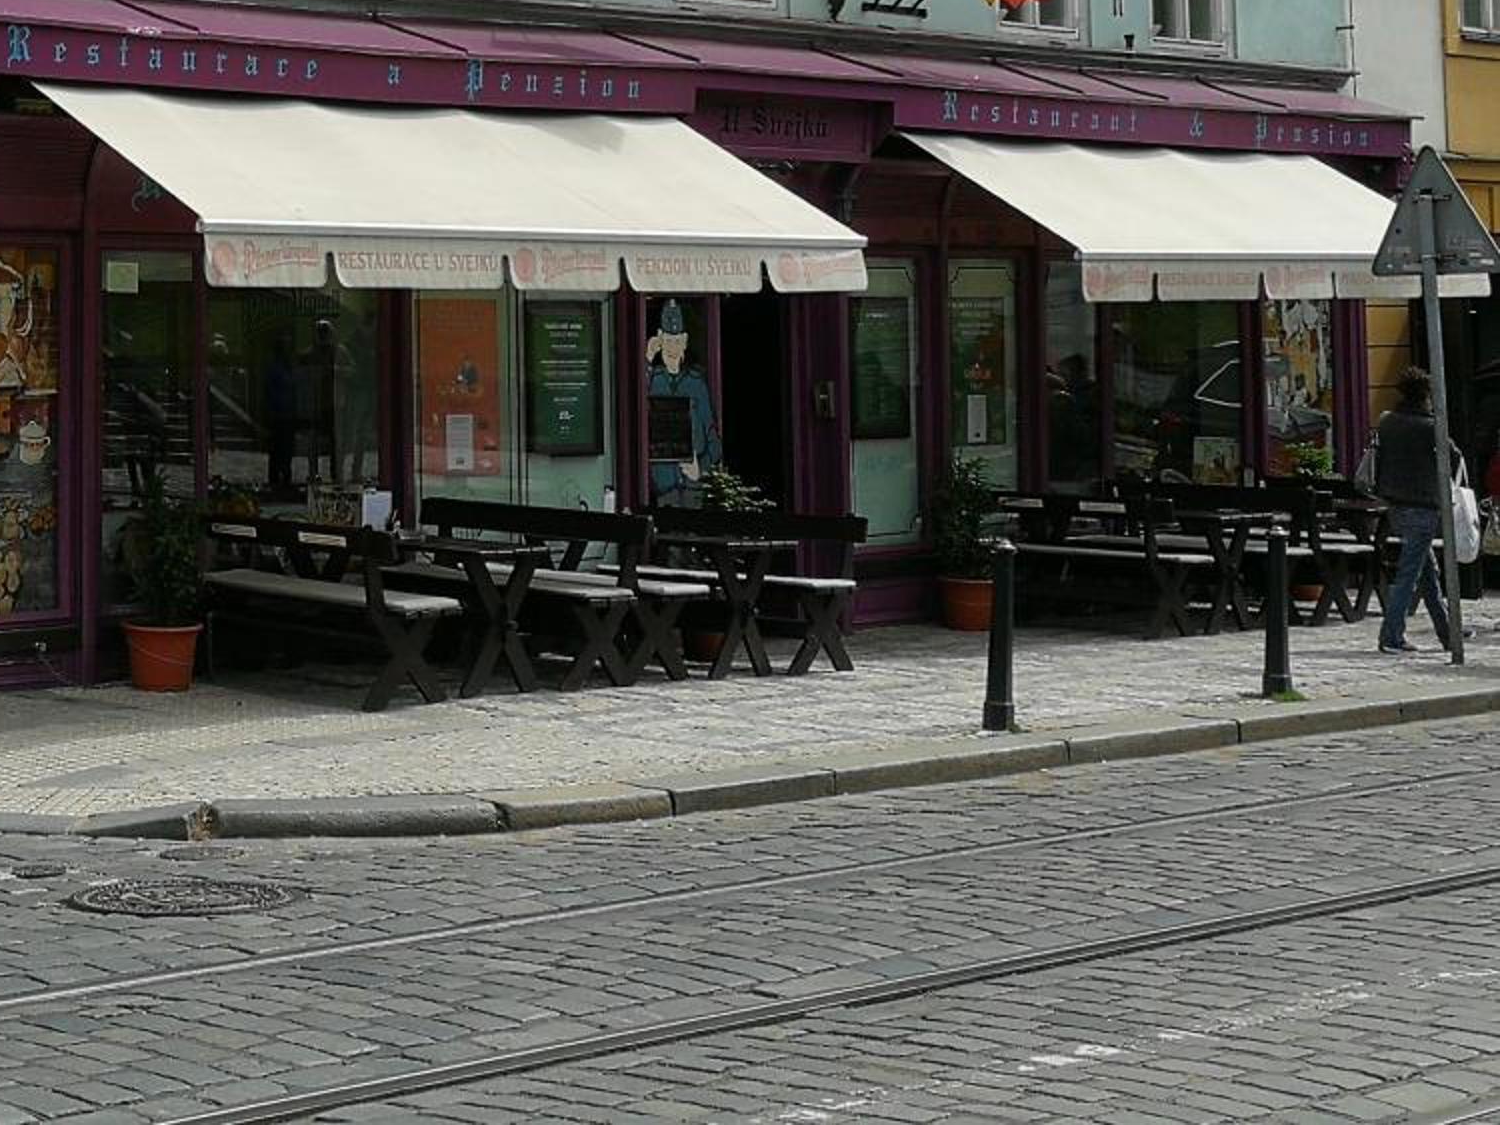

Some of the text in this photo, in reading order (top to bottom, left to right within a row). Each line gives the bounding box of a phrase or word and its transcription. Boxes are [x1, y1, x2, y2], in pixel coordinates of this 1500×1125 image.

[7, 26, 639, 102] Restaurace a Penzion
[942, 91, 1137, 133] Restaurant
[339, 250, 432, 271] RESTAURACE
[636, 255, 690, 275] PENZION
